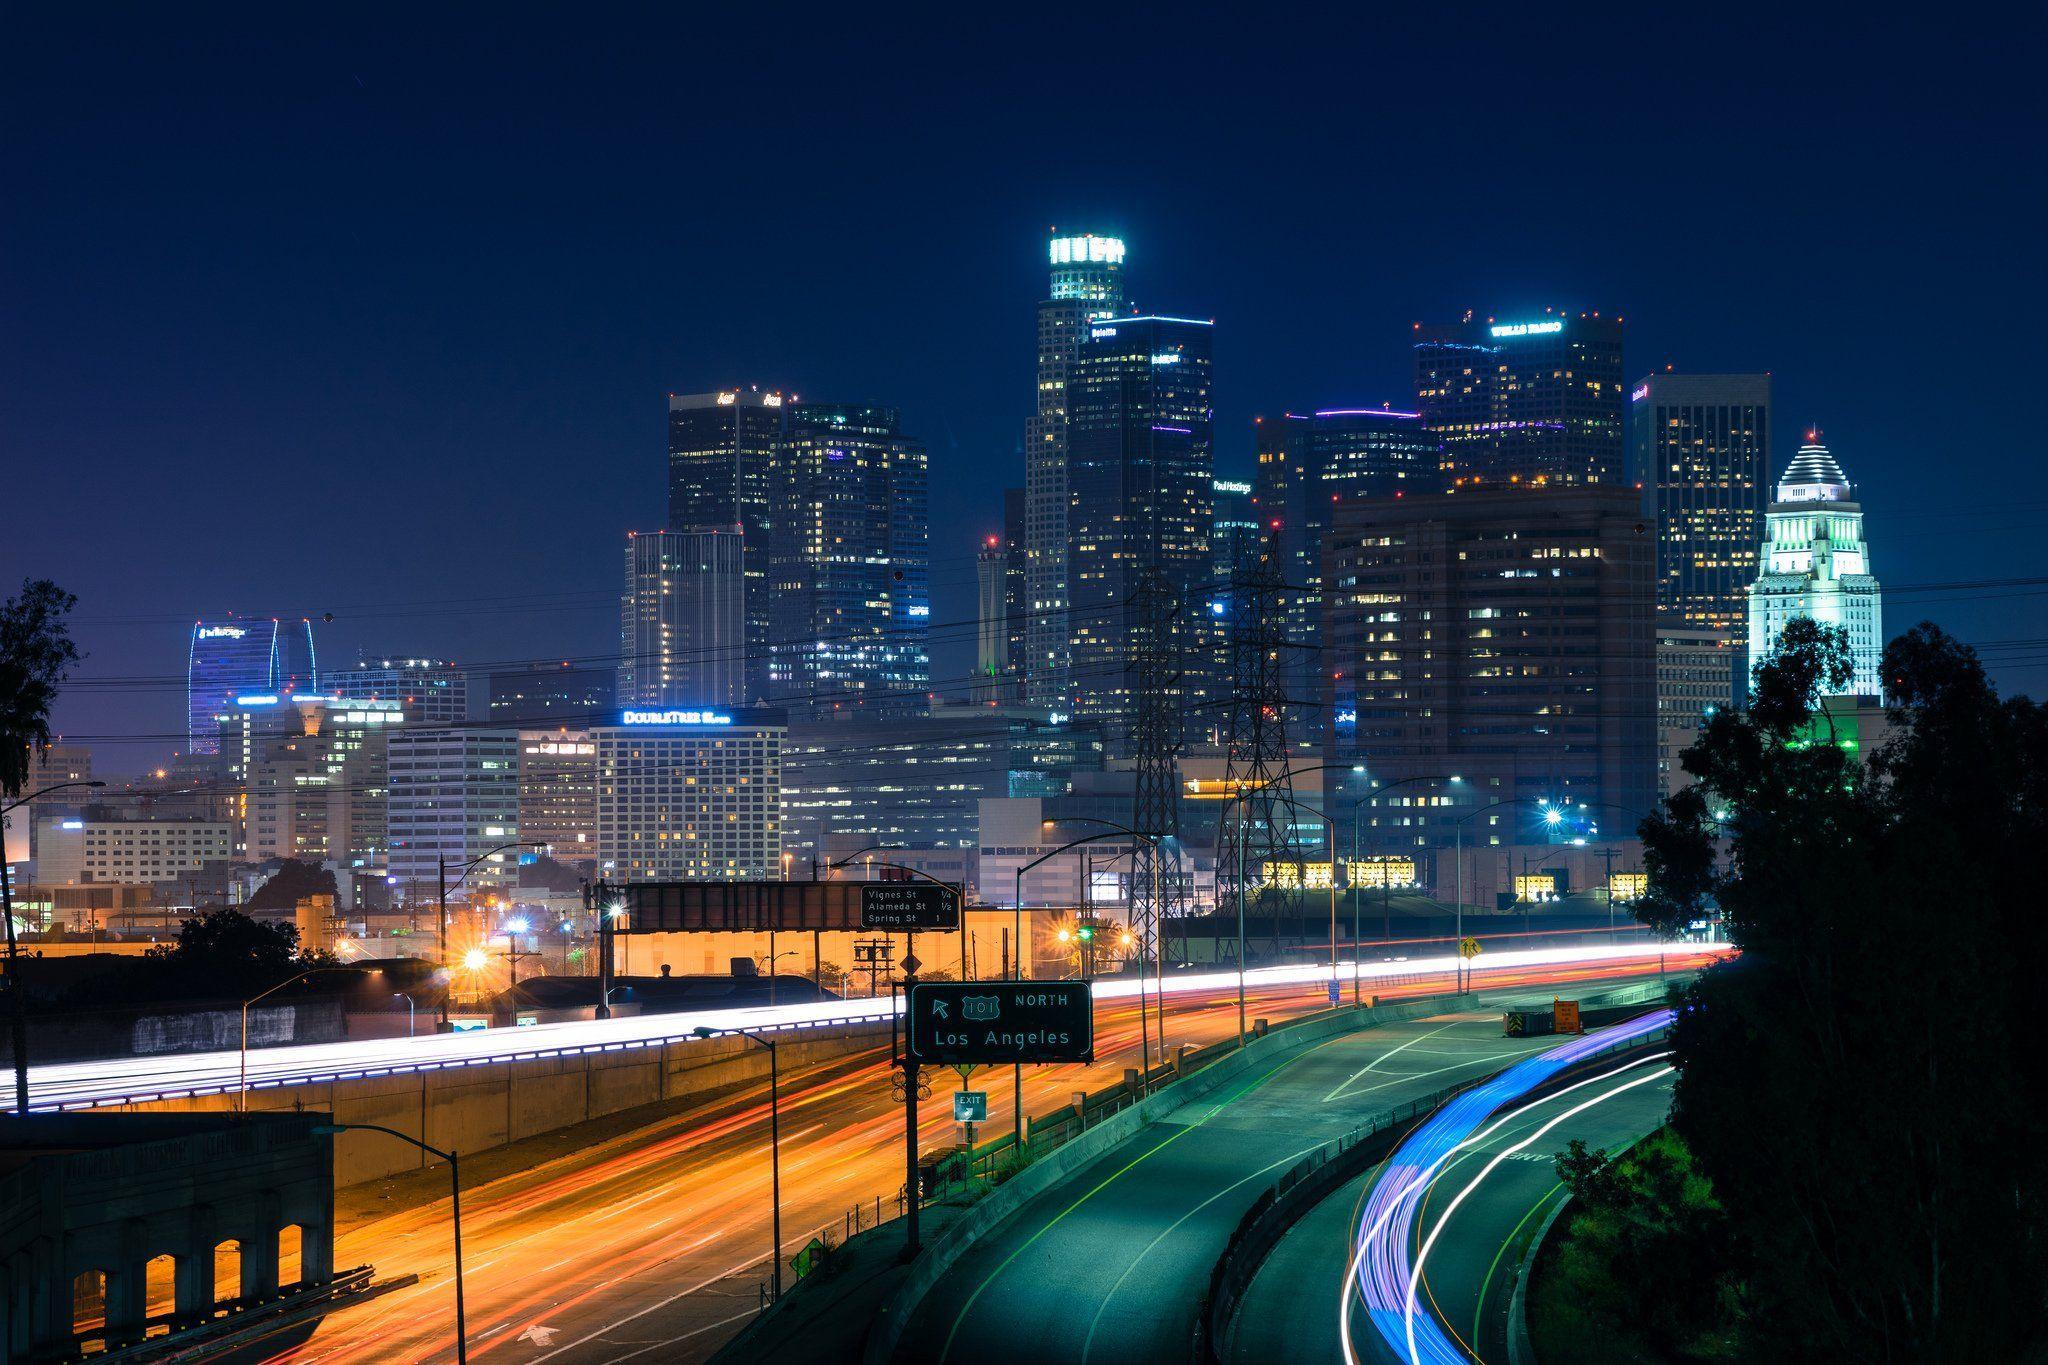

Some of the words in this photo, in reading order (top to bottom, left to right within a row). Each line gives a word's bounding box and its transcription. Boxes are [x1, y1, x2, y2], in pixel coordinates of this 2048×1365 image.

[1491, 324, 1527, 337] WELLS
[1213, 480, 1227, 491] Paul
[1227, 481, 1251, 494] Hastings
[333, 673, 351, 681] ONE
[351, 671, 388, 680] WILSHIRE
[403, 671, 420, 679] ONE
[423, 671, 464, 681] WILSHIRE
[868, 891, 901, 900] Vignes
[906, 891, 917, 899] St
[868, 903, 910, 911] Alameda
[915, 903, 926, 911] St
[868, 914, 900, 924] Spring
[905, 914, 917, 922] St
[969, 1002, 994, 1013] 101
[1015, 994, 1068, 1006] NORTH
[935, 1031, 968, 1045] Los
[984, 1029, 1070, 1051] Angeles
[960, 1096, 981, 1104] EXIT
